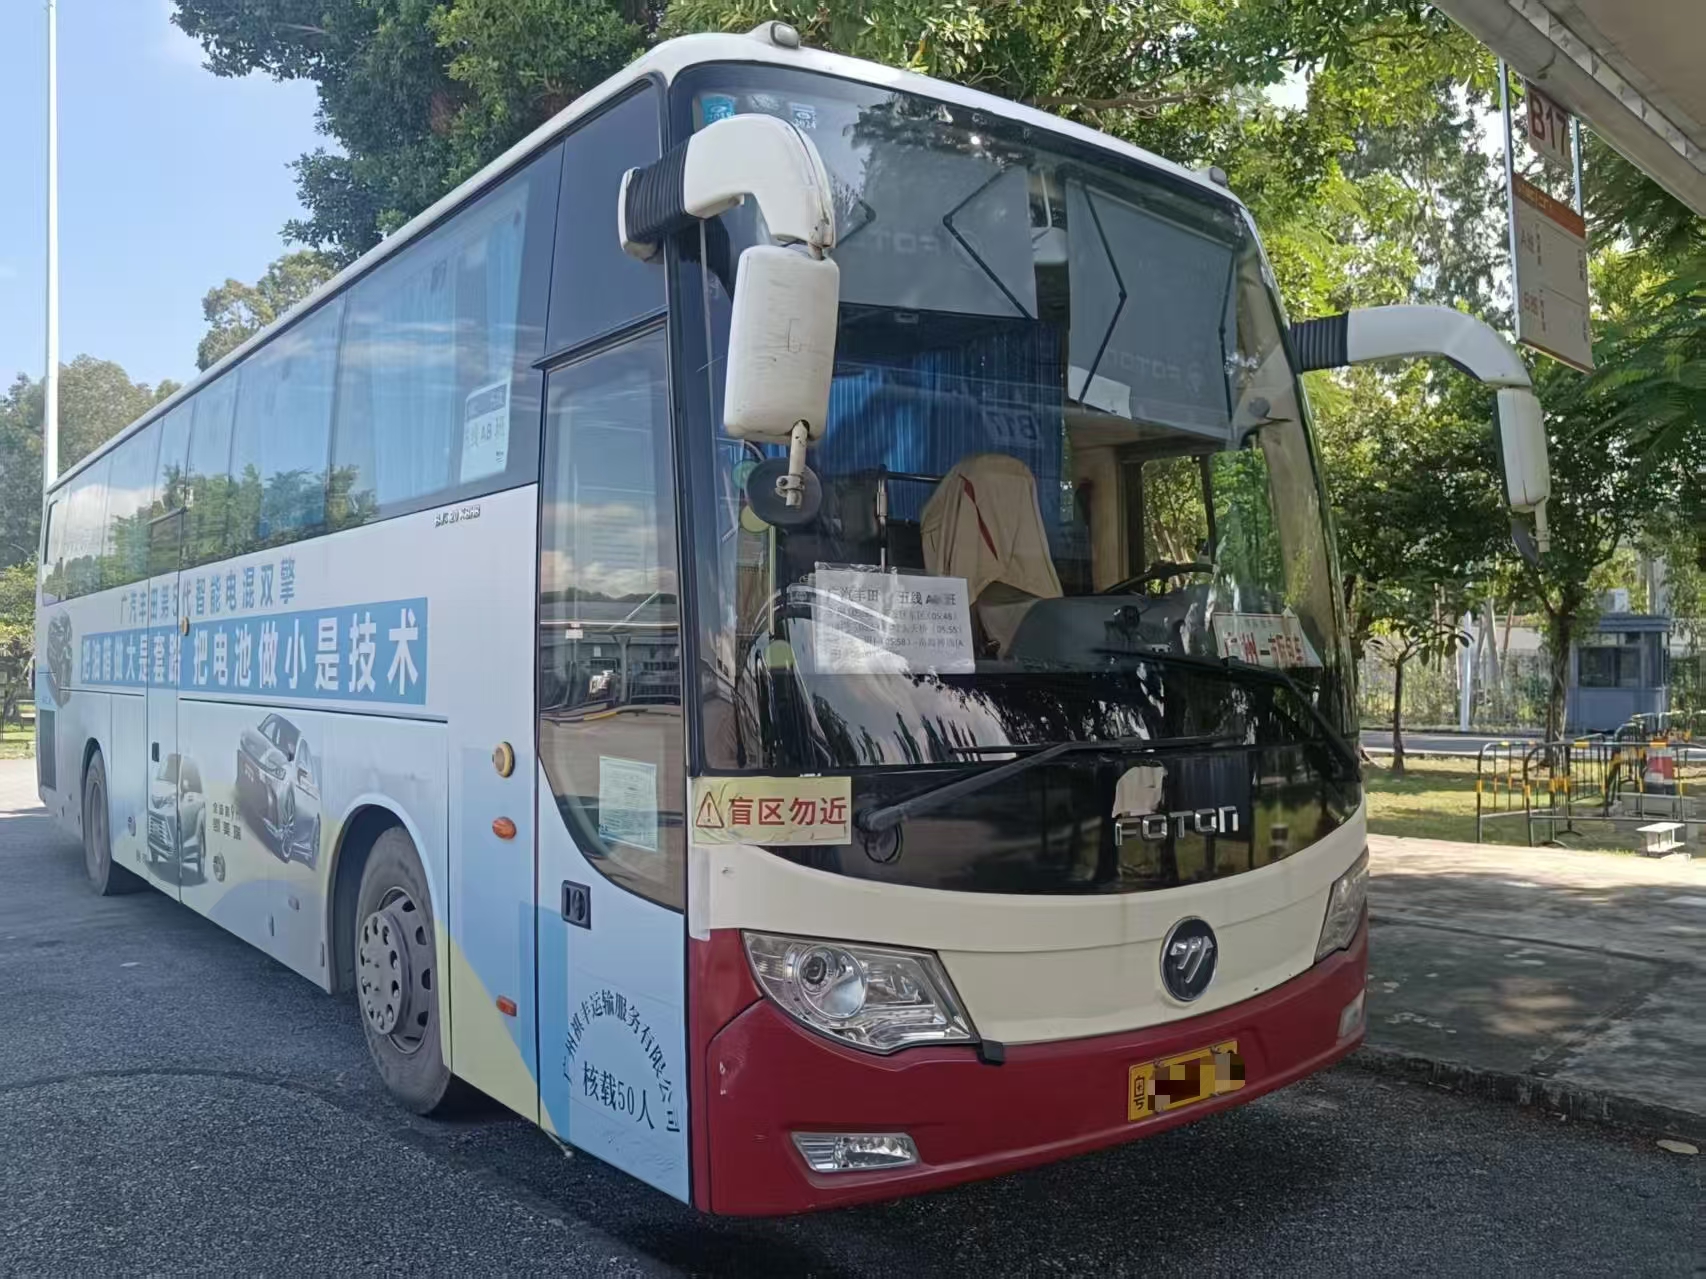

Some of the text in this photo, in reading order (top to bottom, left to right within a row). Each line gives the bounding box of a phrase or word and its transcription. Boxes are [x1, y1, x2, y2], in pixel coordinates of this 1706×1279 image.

[1529, 88, 1567, 156] B17
[193, 607, 419, 696] 把电池做小是技术
[728, 796, 848, 826] 盲区勿近
[1115, 805, 1239, 846] FOTON
[582, 1060, 655, 1130] 核载50人
